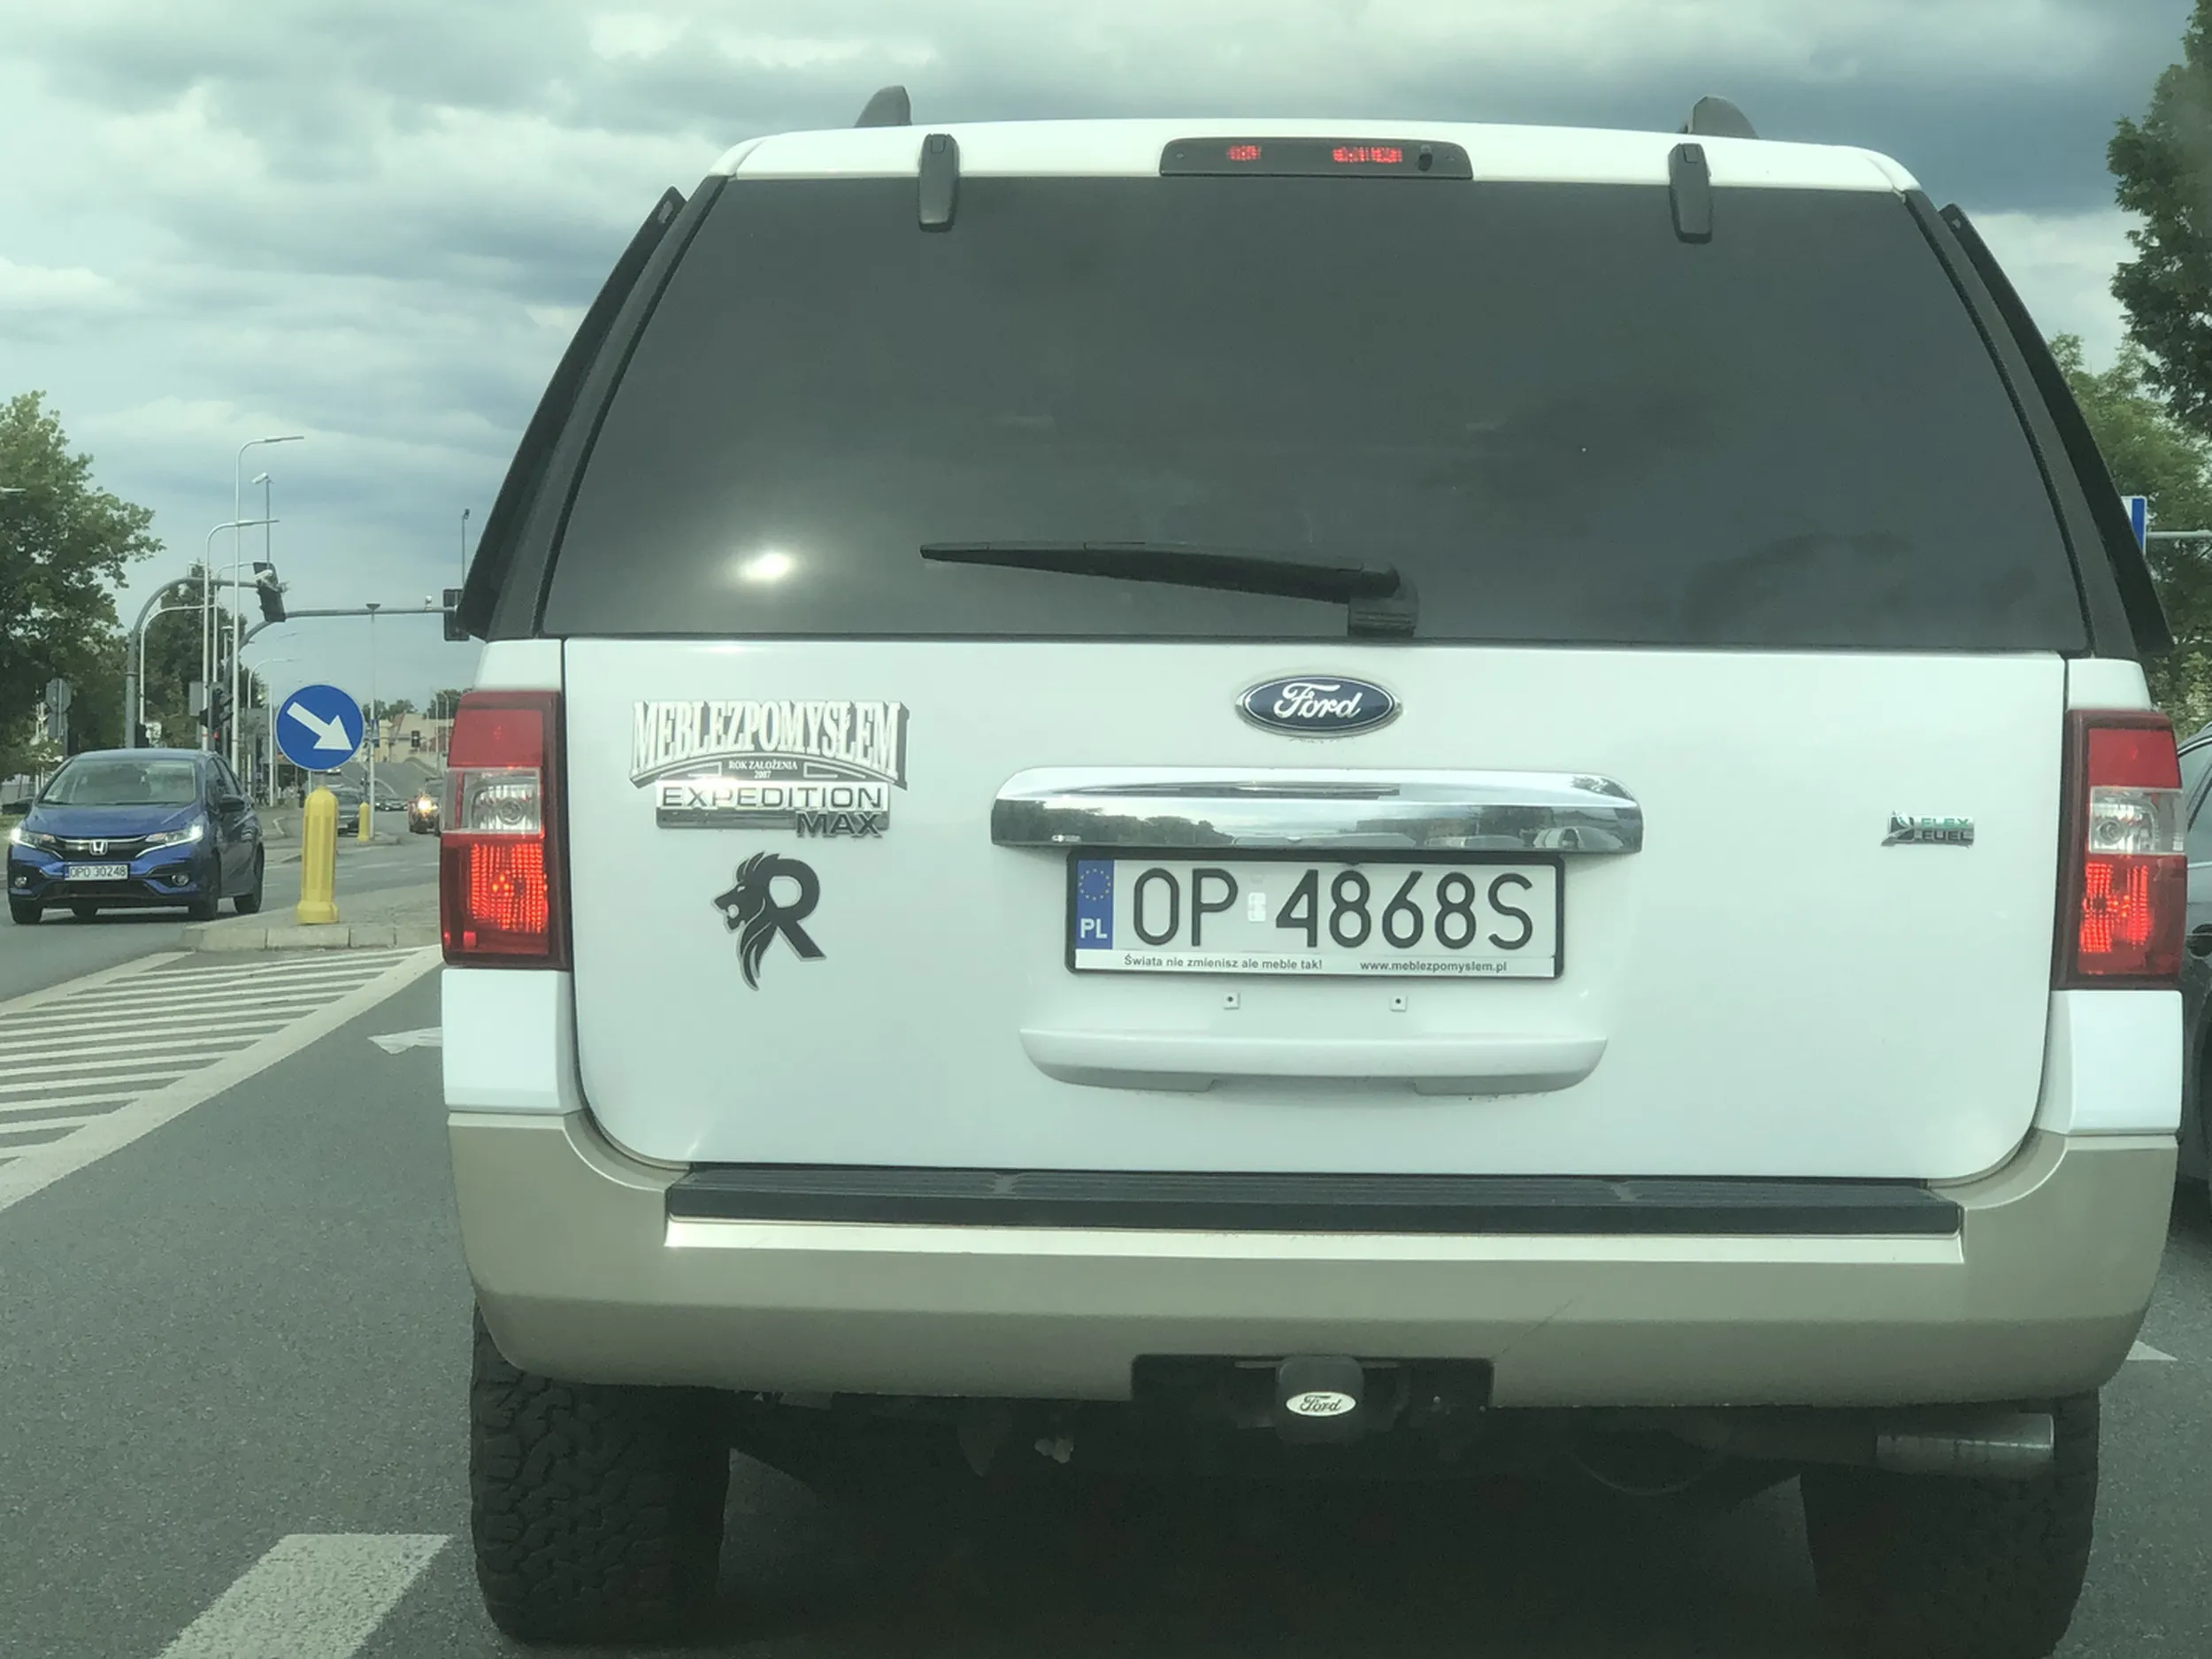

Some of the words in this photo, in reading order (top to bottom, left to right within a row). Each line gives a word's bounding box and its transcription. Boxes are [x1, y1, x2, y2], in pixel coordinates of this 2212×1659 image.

[1273, 682, 1363, 718] Ford
[632, 700, 906, 781] MEBLEZPOMYSŁEM
[728, 760, 748, 770] ROK
[754, 770, 772, 779] 2007
[663, 787, 882, 808] EXPEDITION
[796, 810, 884, 838] MAX
[1133, 867, 1239, 948] OP
[1275, 869, 1533, 949] 4868S
[1080, 918, 1109, 939] PL
[1124, 953, 1163, 967] Świata
[1166, 956, 1184, 967] nie
[1187, 956, 1239, 969] zmienisz
[1241, 957, 1259, 969] ale
[1262, 958, 1298, 970] meble
[1301, 959, 1323, 970] tak!
[1360, 961, 1508, 973] www.meblezpomyslem.pl
[1300, 1394, 1342, 1412] Ford
